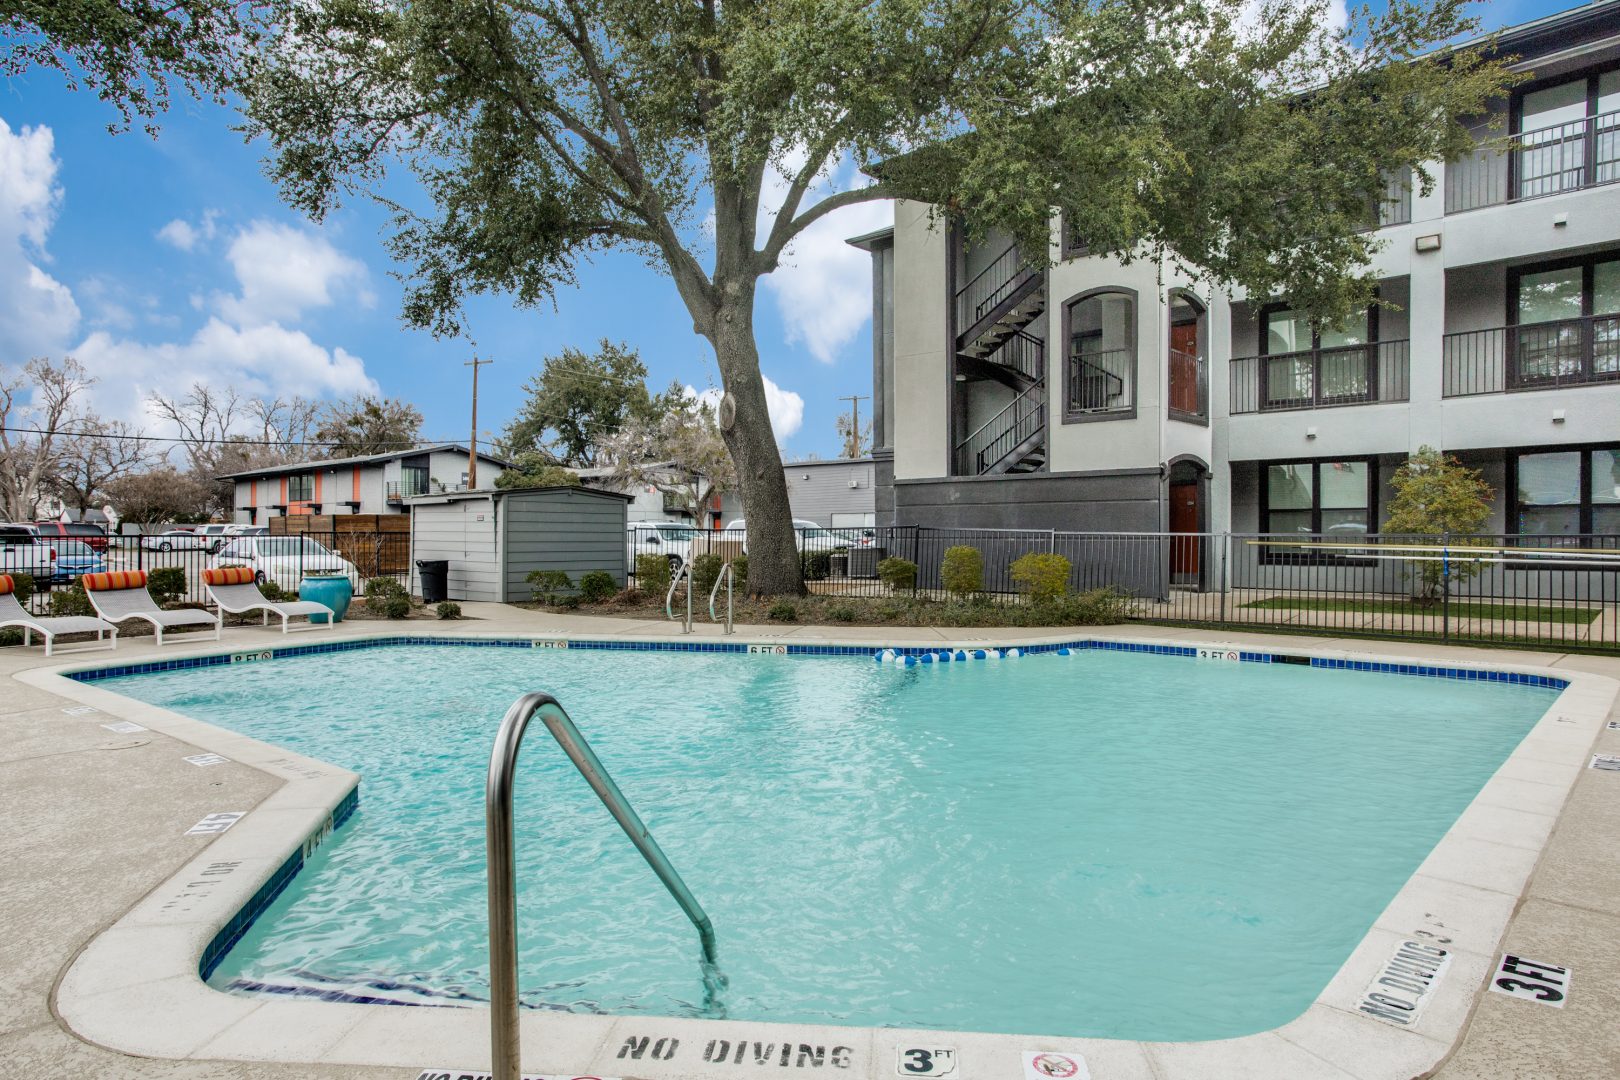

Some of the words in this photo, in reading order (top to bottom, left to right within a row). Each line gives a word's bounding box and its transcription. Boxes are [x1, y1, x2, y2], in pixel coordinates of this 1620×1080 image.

[246, 653, 259, 662] FT
[761, 646, 773, 655] FT
[1211, 651, 1224, 660] FT
[1378, 940, 1448, 996] DIVING
[1495, 977, 1564, 1002] 3
[1359, 992, 1416, 1025] NO
[615, 1035, 680, 1061] NO
[702, 1038, 854, 1069] DIVING
[903, 1048, 934, 1073] 3
[934, 1049, 953, 1059] FT
